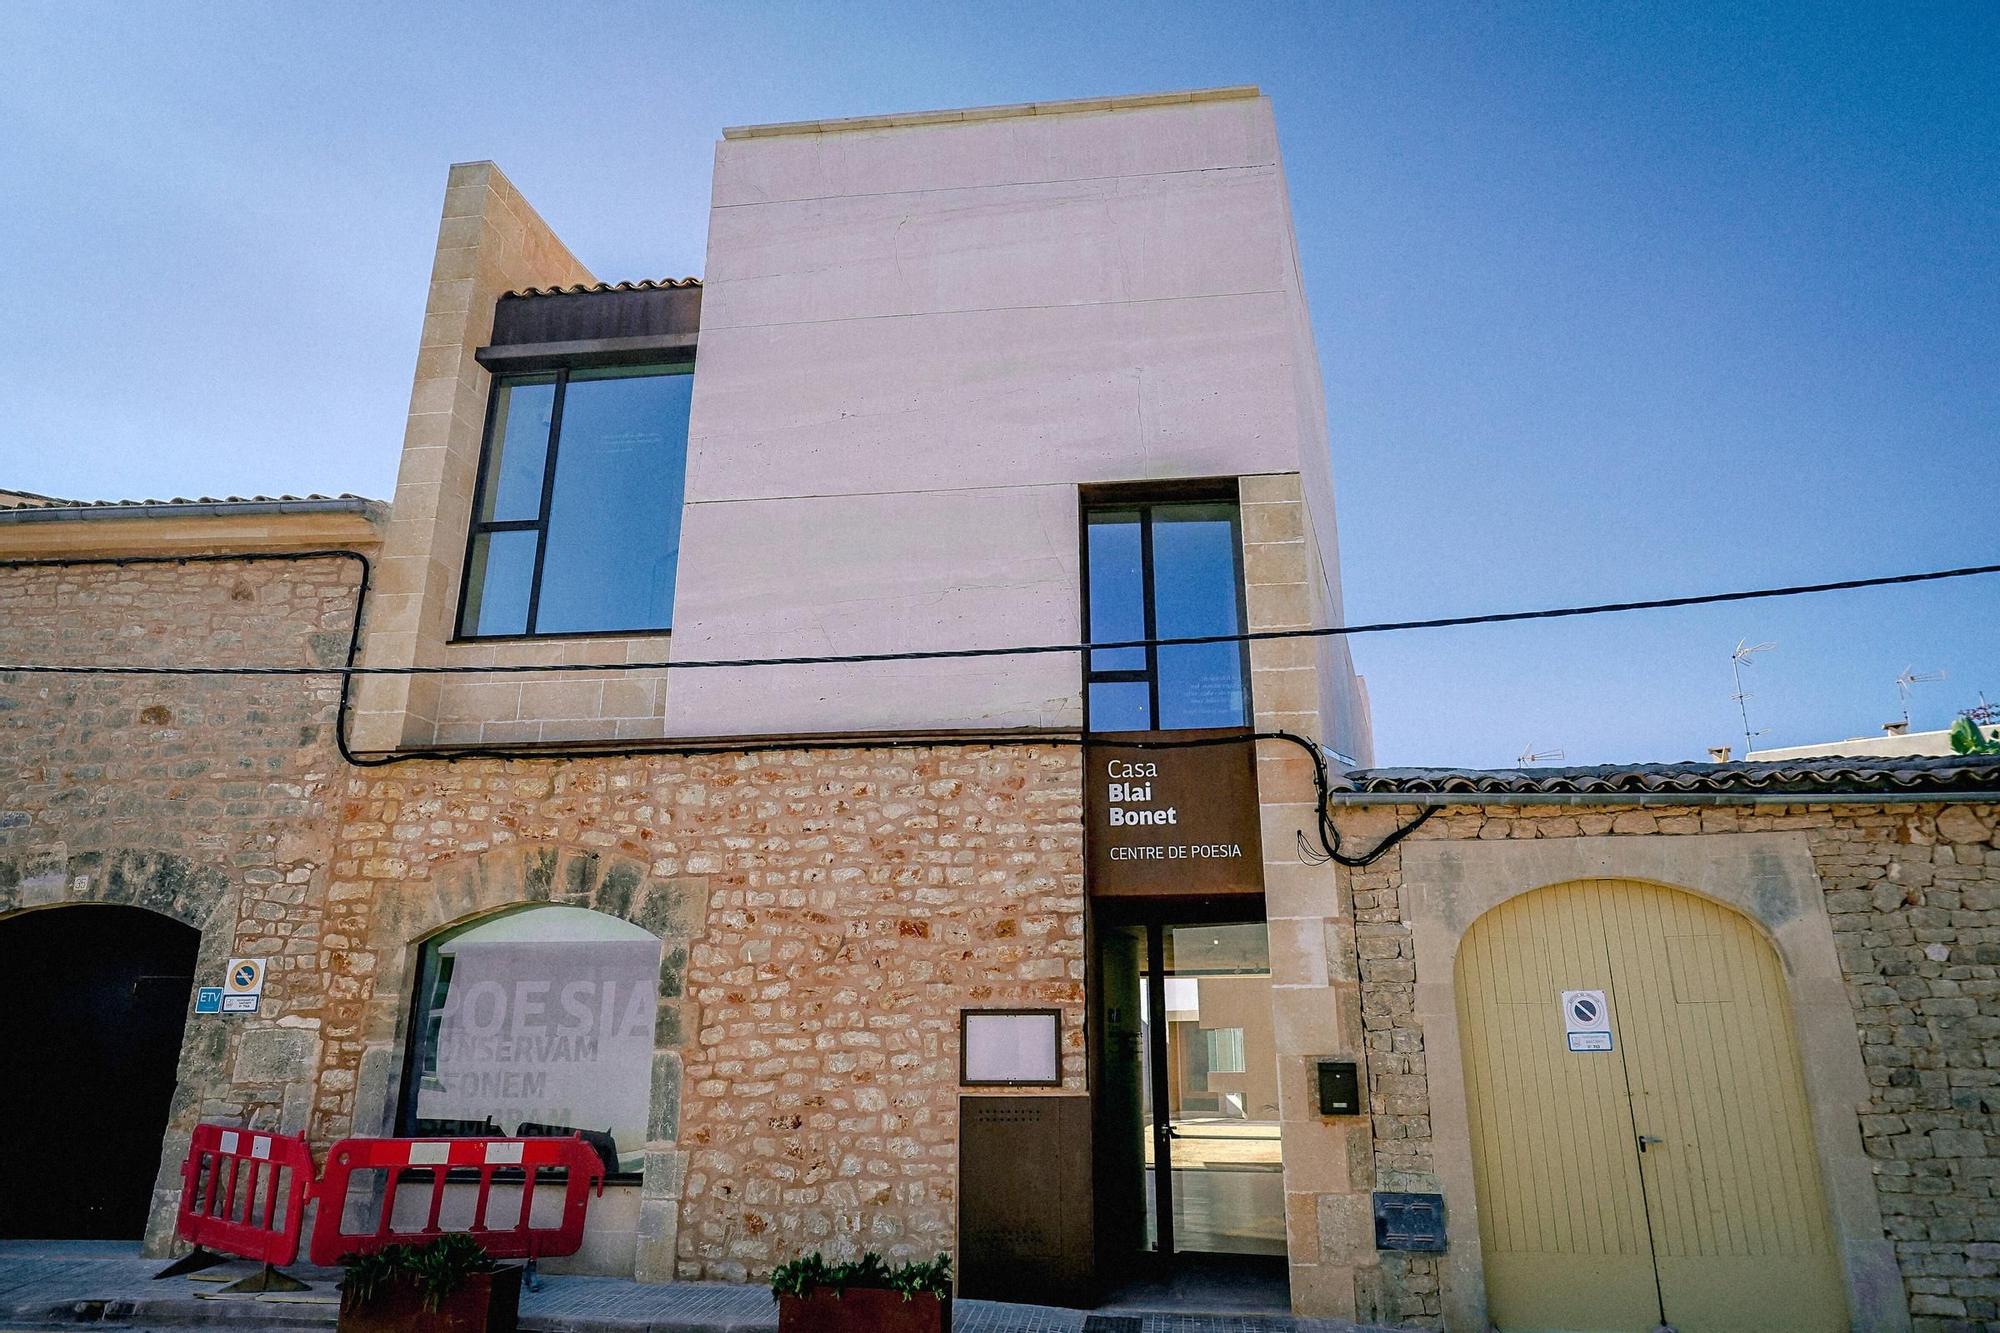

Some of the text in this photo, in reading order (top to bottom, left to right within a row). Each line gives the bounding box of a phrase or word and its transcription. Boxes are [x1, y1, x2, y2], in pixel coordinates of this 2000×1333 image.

[1107, 759, 1158, 778] Casa
[1108, 781, 1152, 802] Blai
[1109, 806, 1177, 827] Bonet
[1110, 844, 1242, 860] CENTRE DE POESIA
[200, 992, 221, 1003] ETV
